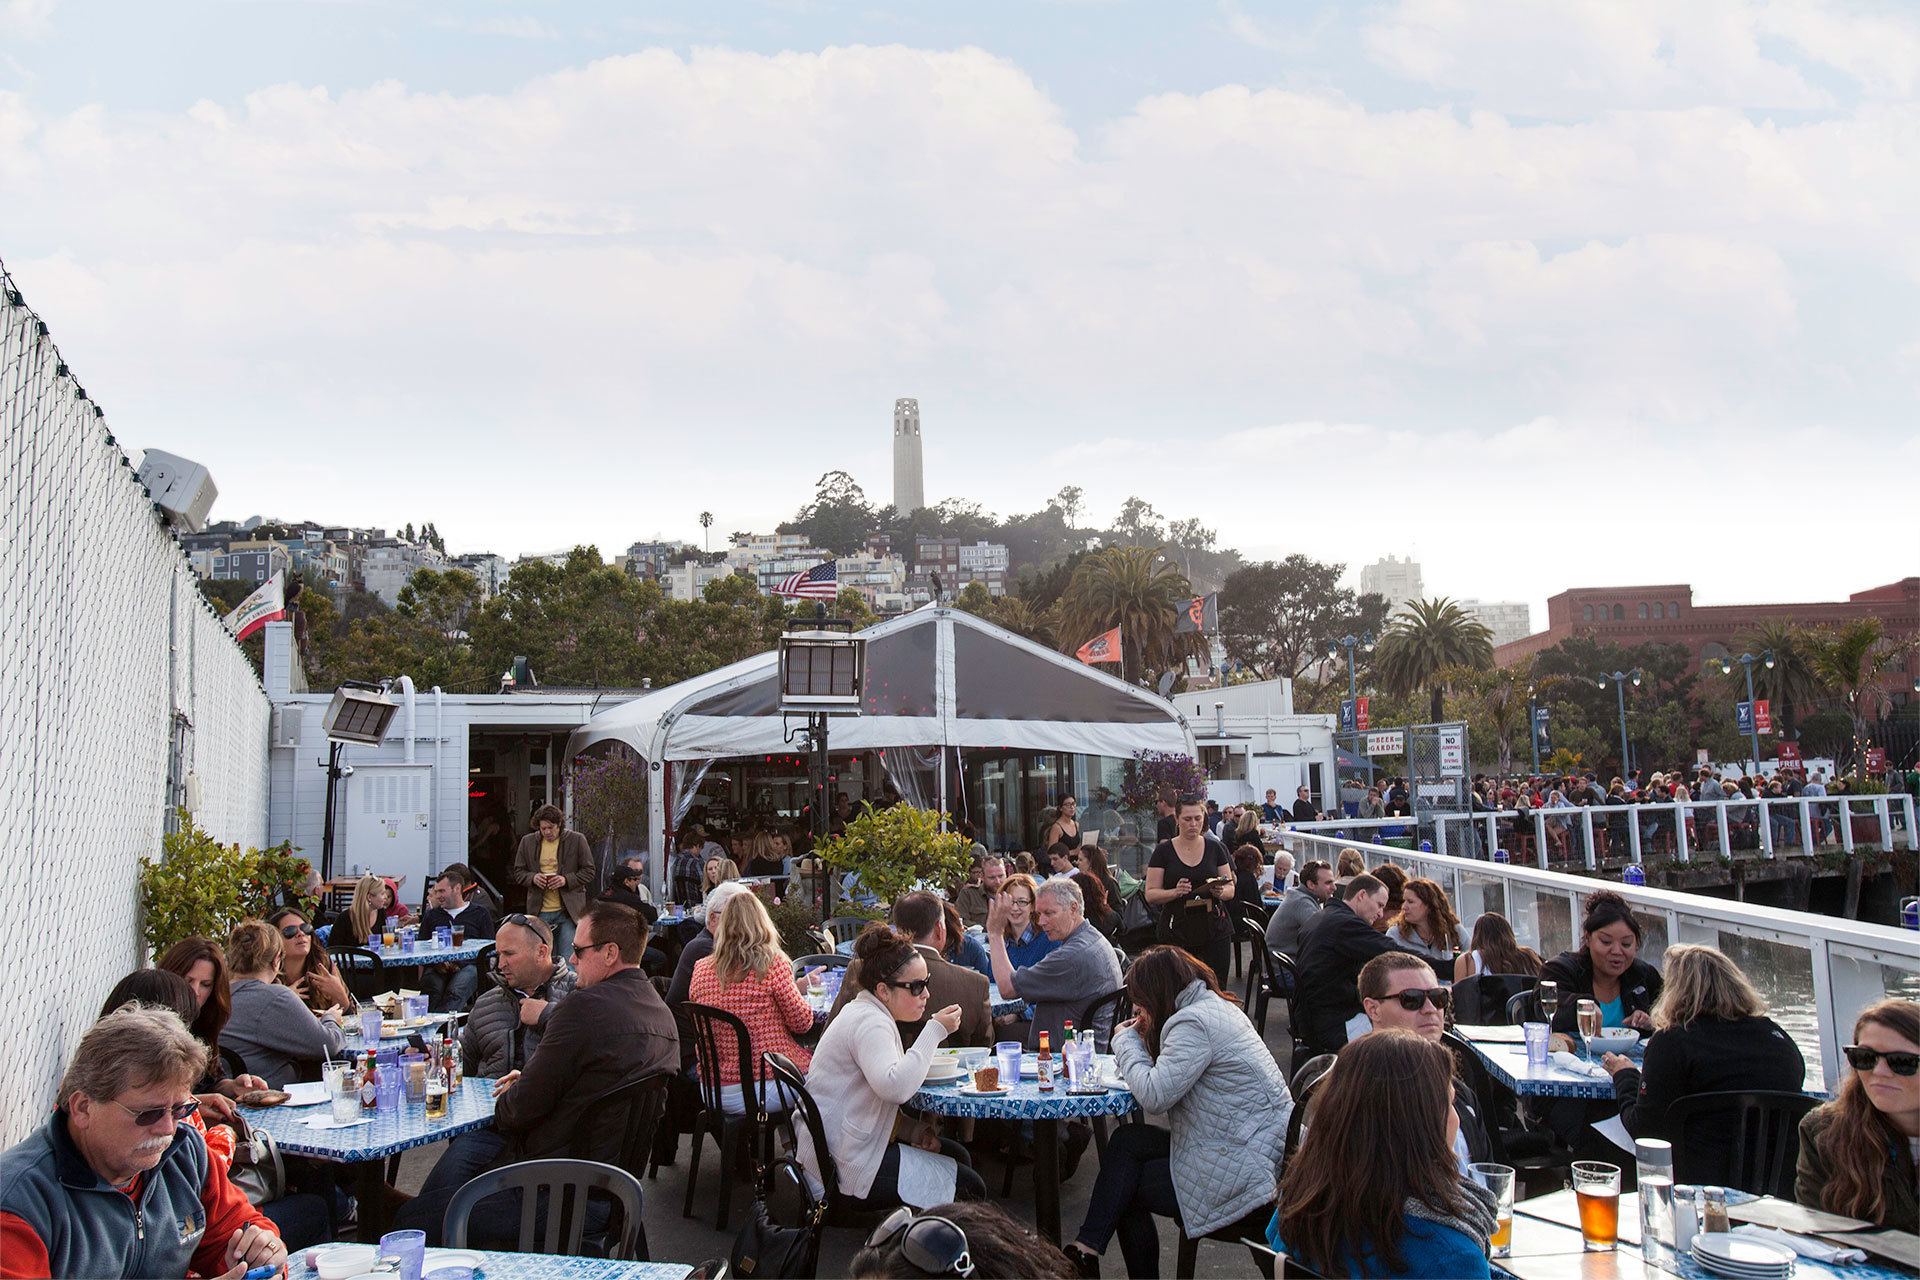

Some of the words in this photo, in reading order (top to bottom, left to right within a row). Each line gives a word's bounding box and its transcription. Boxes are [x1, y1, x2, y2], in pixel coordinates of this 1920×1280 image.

[1445, 737, 1455, 745] NO
[1370, 744, 1400, 752] GARDEN
[1779, 759, 1801, 769] FREE
